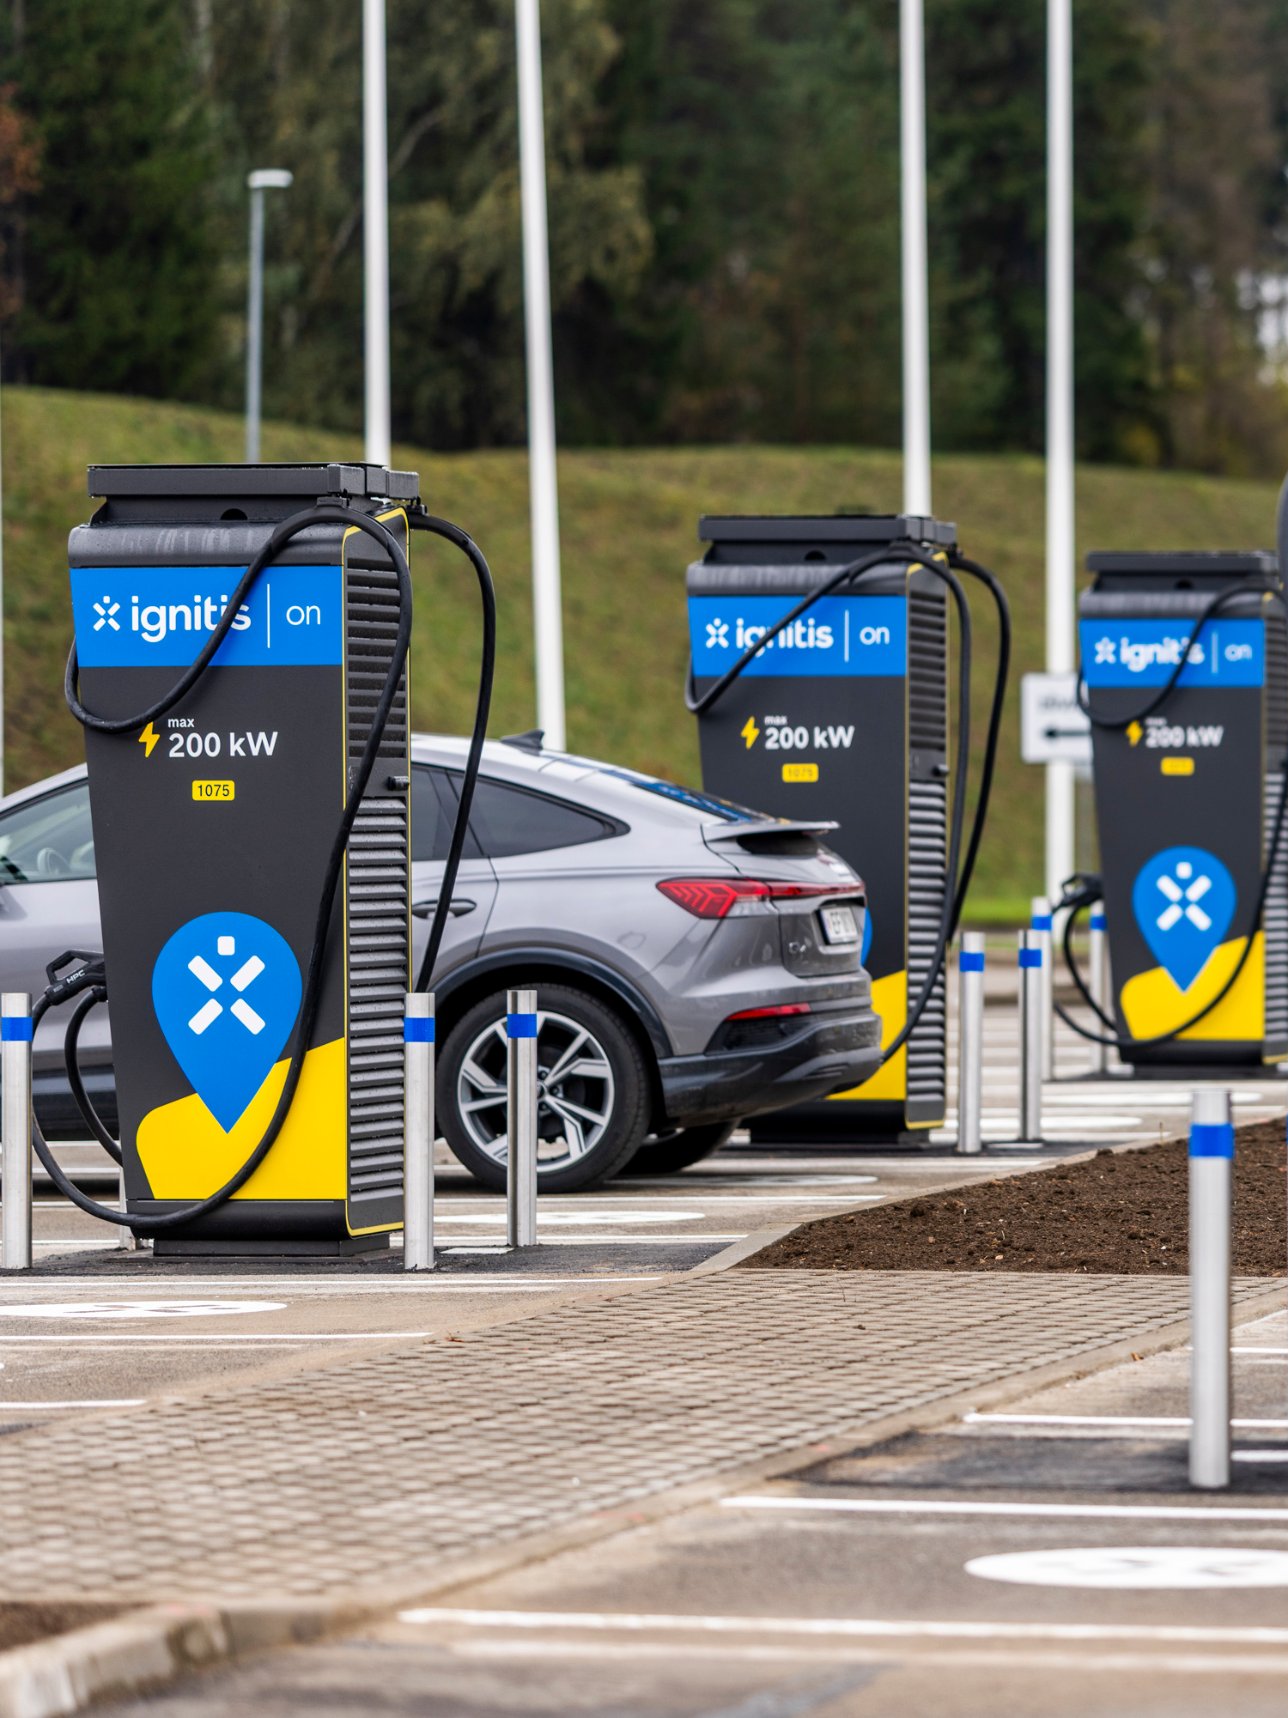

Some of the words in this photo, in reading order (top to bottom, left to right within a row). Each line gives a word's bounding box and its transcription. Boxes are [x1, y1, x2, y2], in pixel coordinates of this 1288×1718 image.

[286, 606, 320, 625] on
[860, 627, 889, 644] on
[168, 719, 194, 727] max
[169, 732, 220, 757] 200
[230, 732, 278, 756] kW
[765, 727, 809, 749] 200
[814, 726, 854, 748] kW
[197, 784, 230, 797] 1075
[66, 969, 86, 984] HPC
